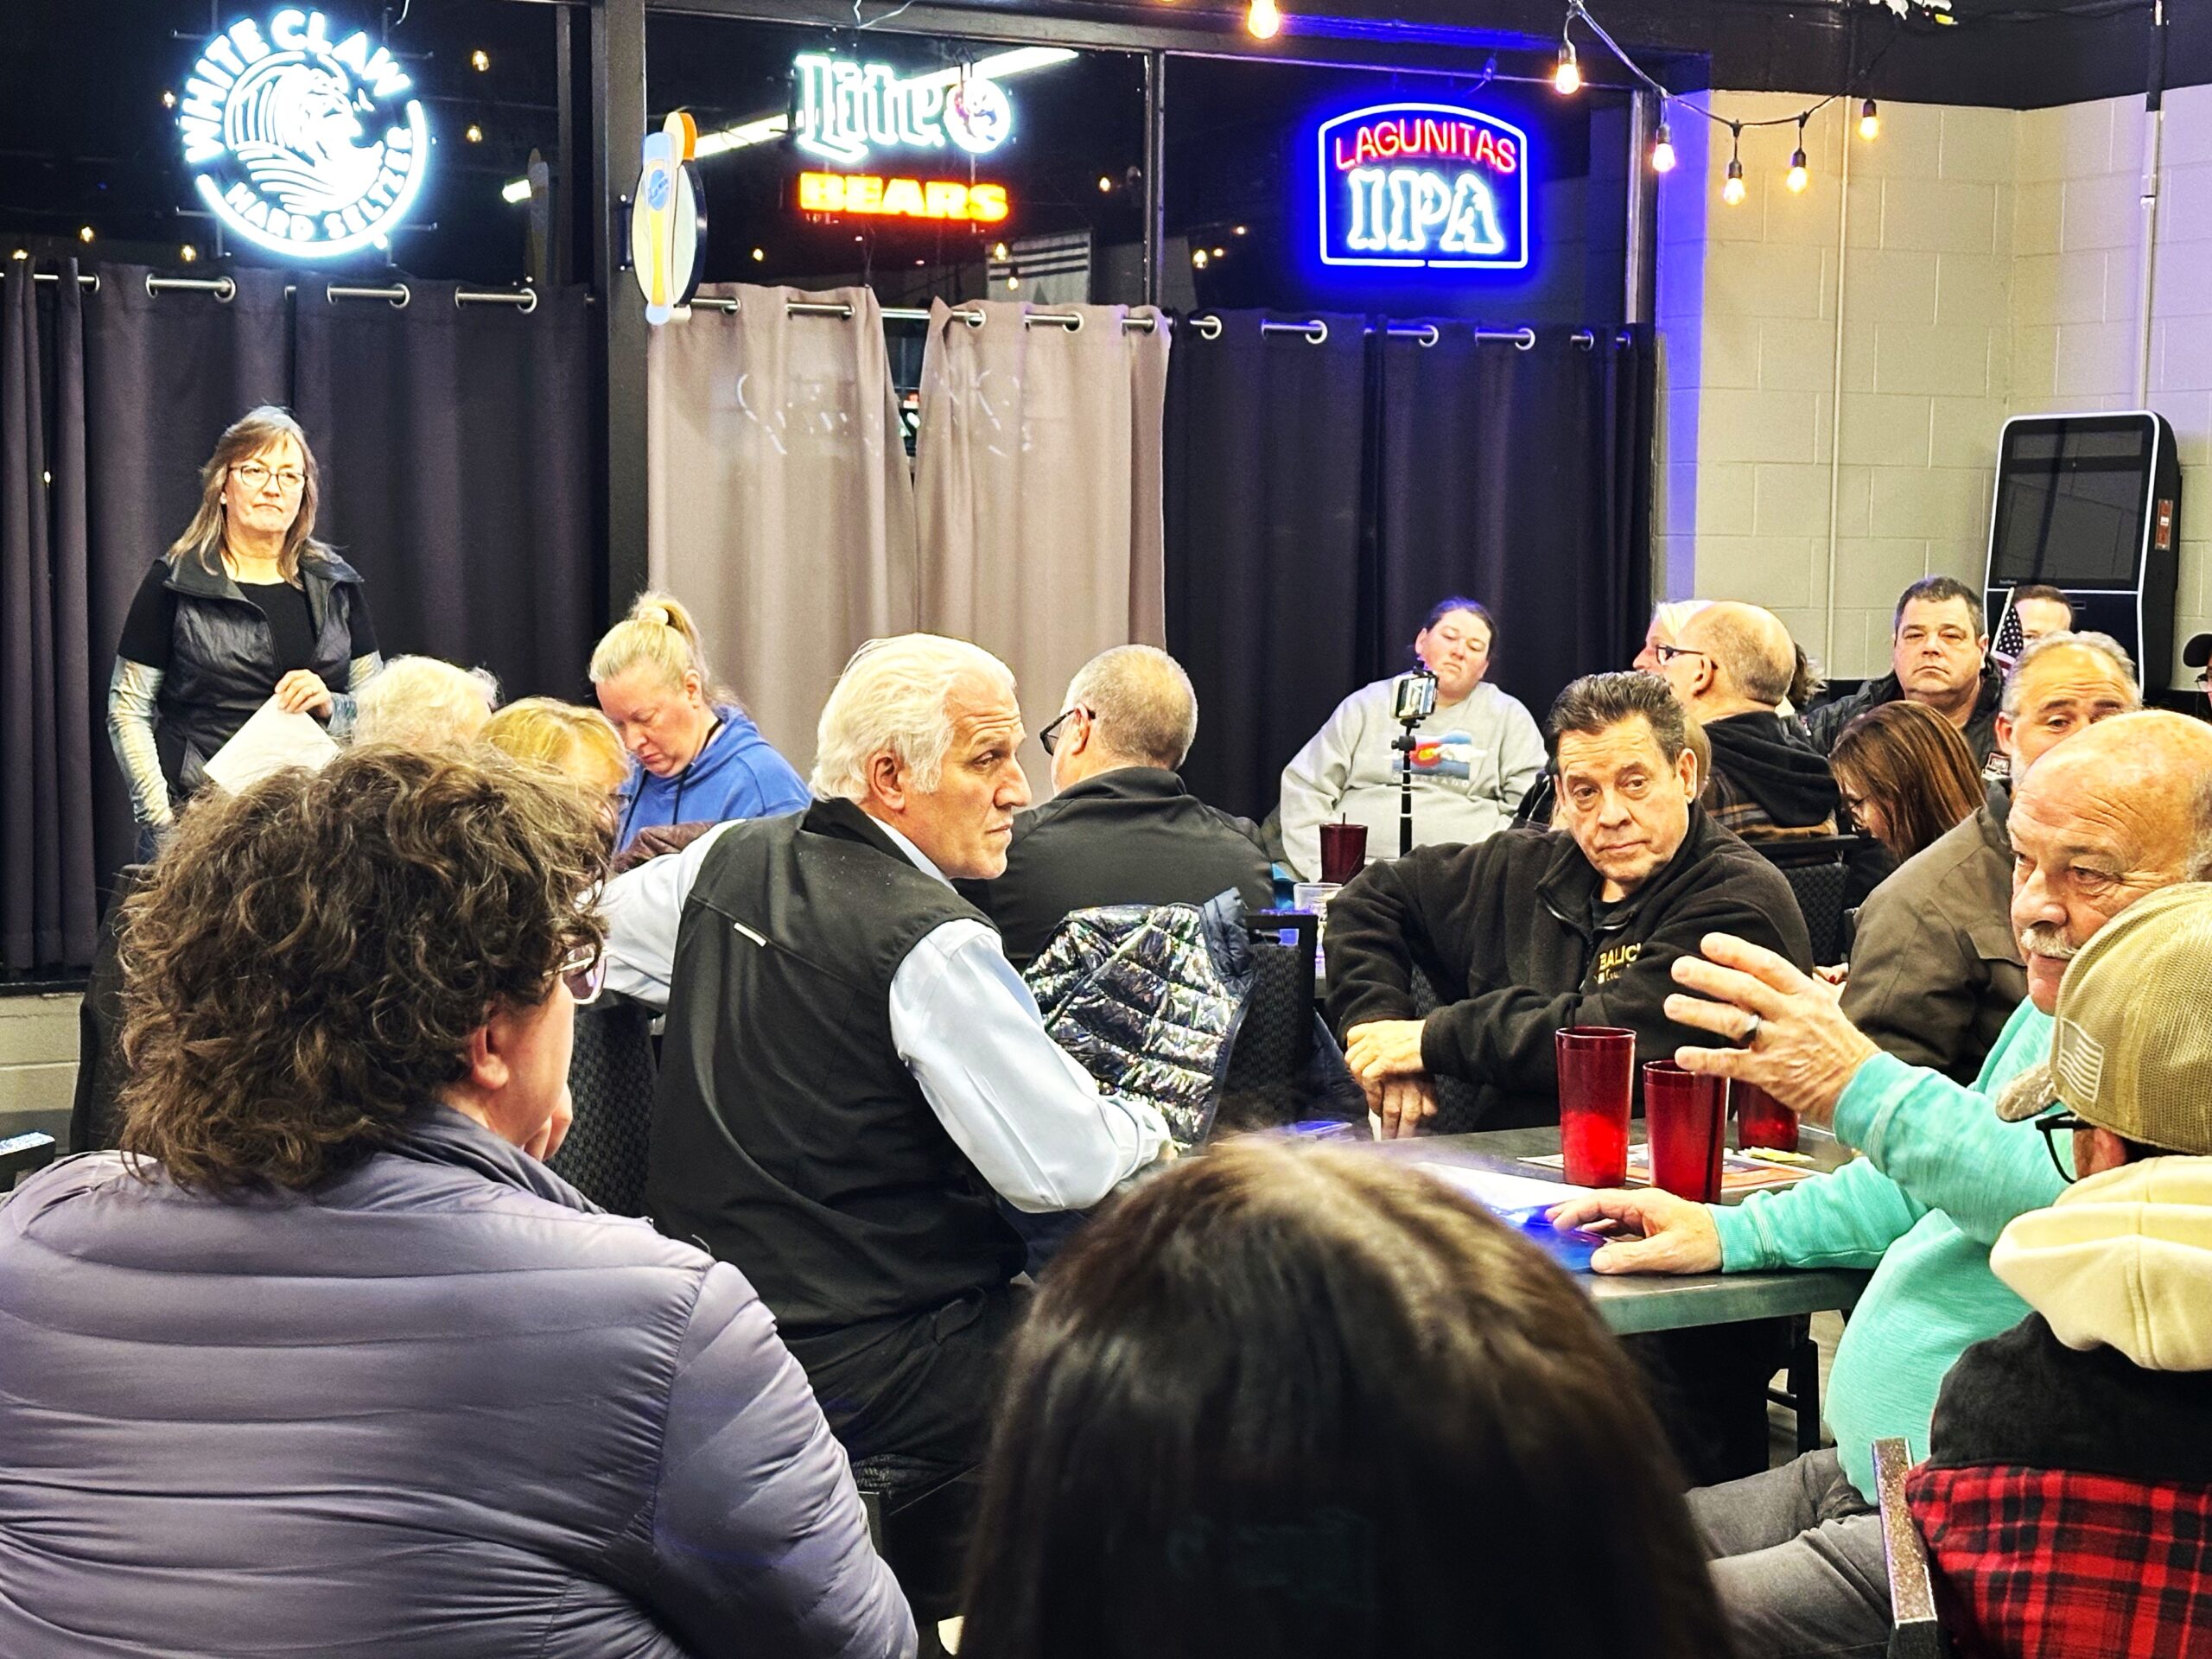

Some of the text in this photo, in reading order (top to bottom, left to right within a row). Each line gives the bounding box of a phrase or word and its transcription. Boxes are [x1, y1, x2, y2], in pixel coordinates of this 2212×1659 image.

[180, 9, 411, 163] WHITE CLAW
[225, 126, 413, 242] HARD SELTZER
[1335, 118, 1516, 174] LAGUNITAS
[800, 172, 1009, 222] BEARS
[1347, 168, 1505, 254] IPA
